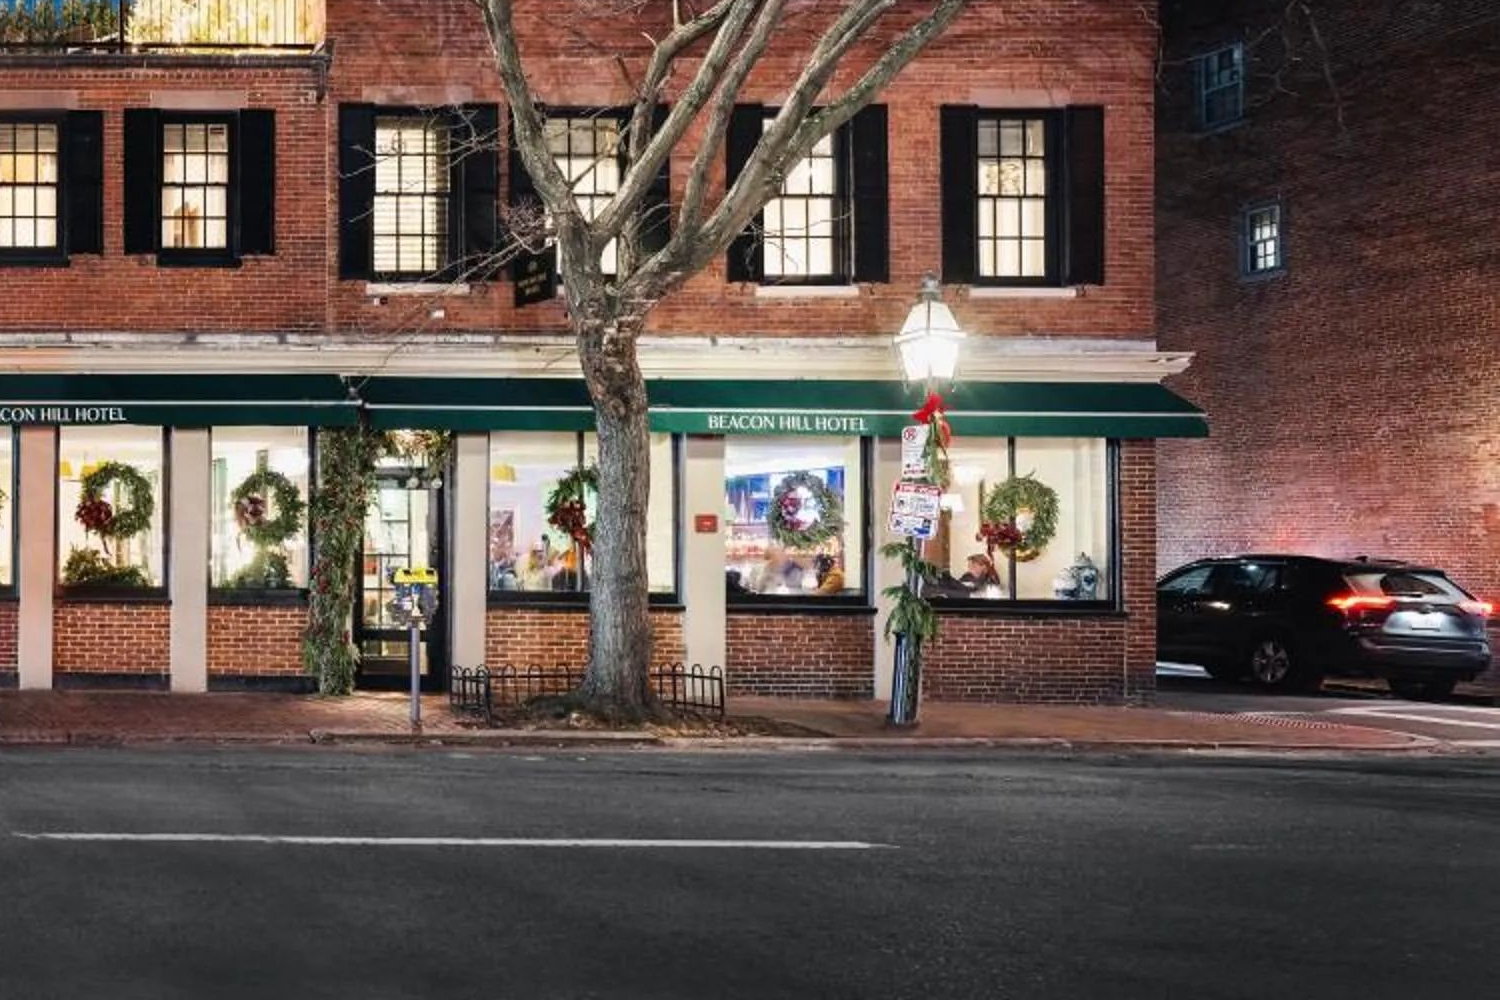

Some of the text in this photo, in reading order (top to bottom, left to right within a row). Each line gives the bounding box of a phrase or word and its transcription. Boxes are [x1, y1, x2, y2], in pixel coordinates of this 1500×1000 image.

[41, 407, 73, 422] HILL
[75, 407, 127, 422] HOTEL
[708, 414, 868, 432] BEACON HILL HOTEL
